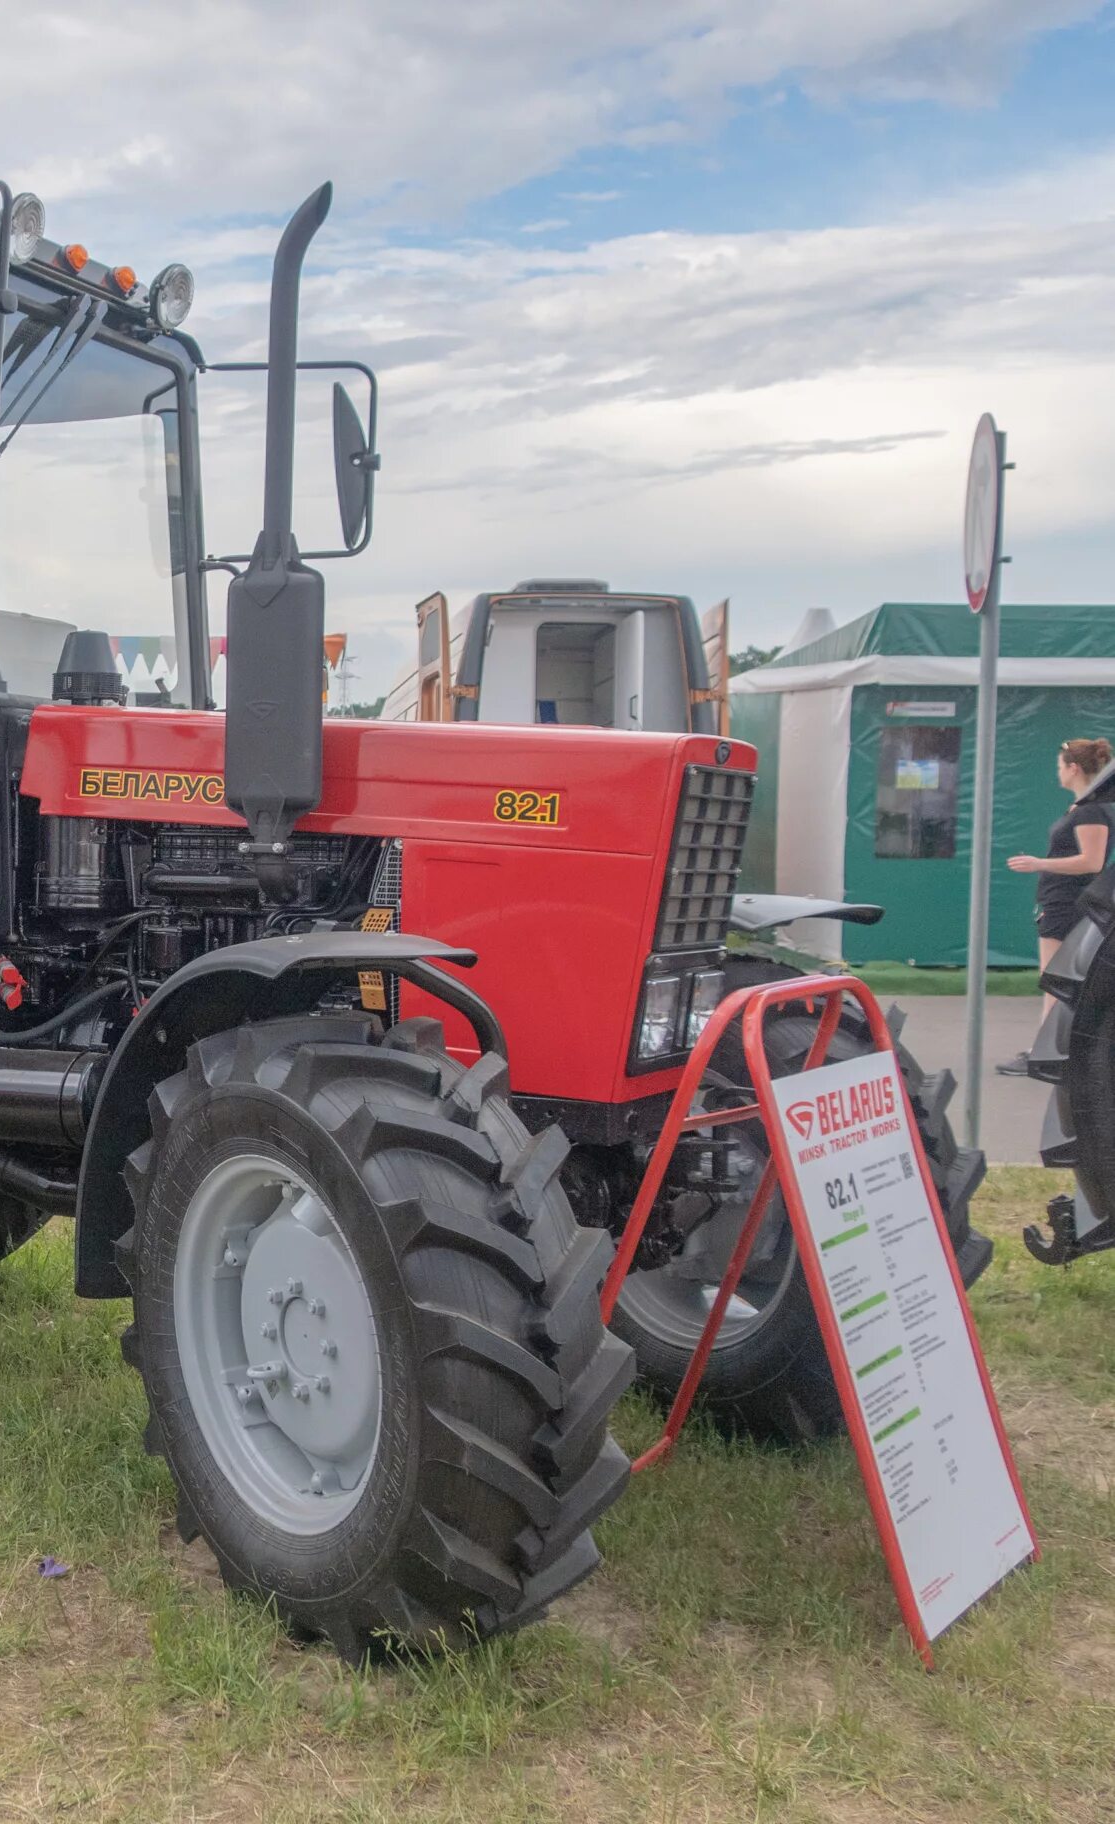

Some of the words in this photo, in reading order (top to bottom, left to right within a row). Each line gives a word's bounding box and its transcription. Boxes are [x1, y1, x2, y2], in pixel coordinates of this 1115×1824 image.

[80, 768, 224, 804] БЕЛАРУС
[494, 790, 560, 824] 82.1
[816, 1076, 895, 1136] BELARUS
[798, 1143, 827, 1166] MINSK
[829, 1130, 869, 1154] TRACTOR
[871, 1118, 901, 1139] WORKS
[825, 1172, 859, 1210] 82.1
